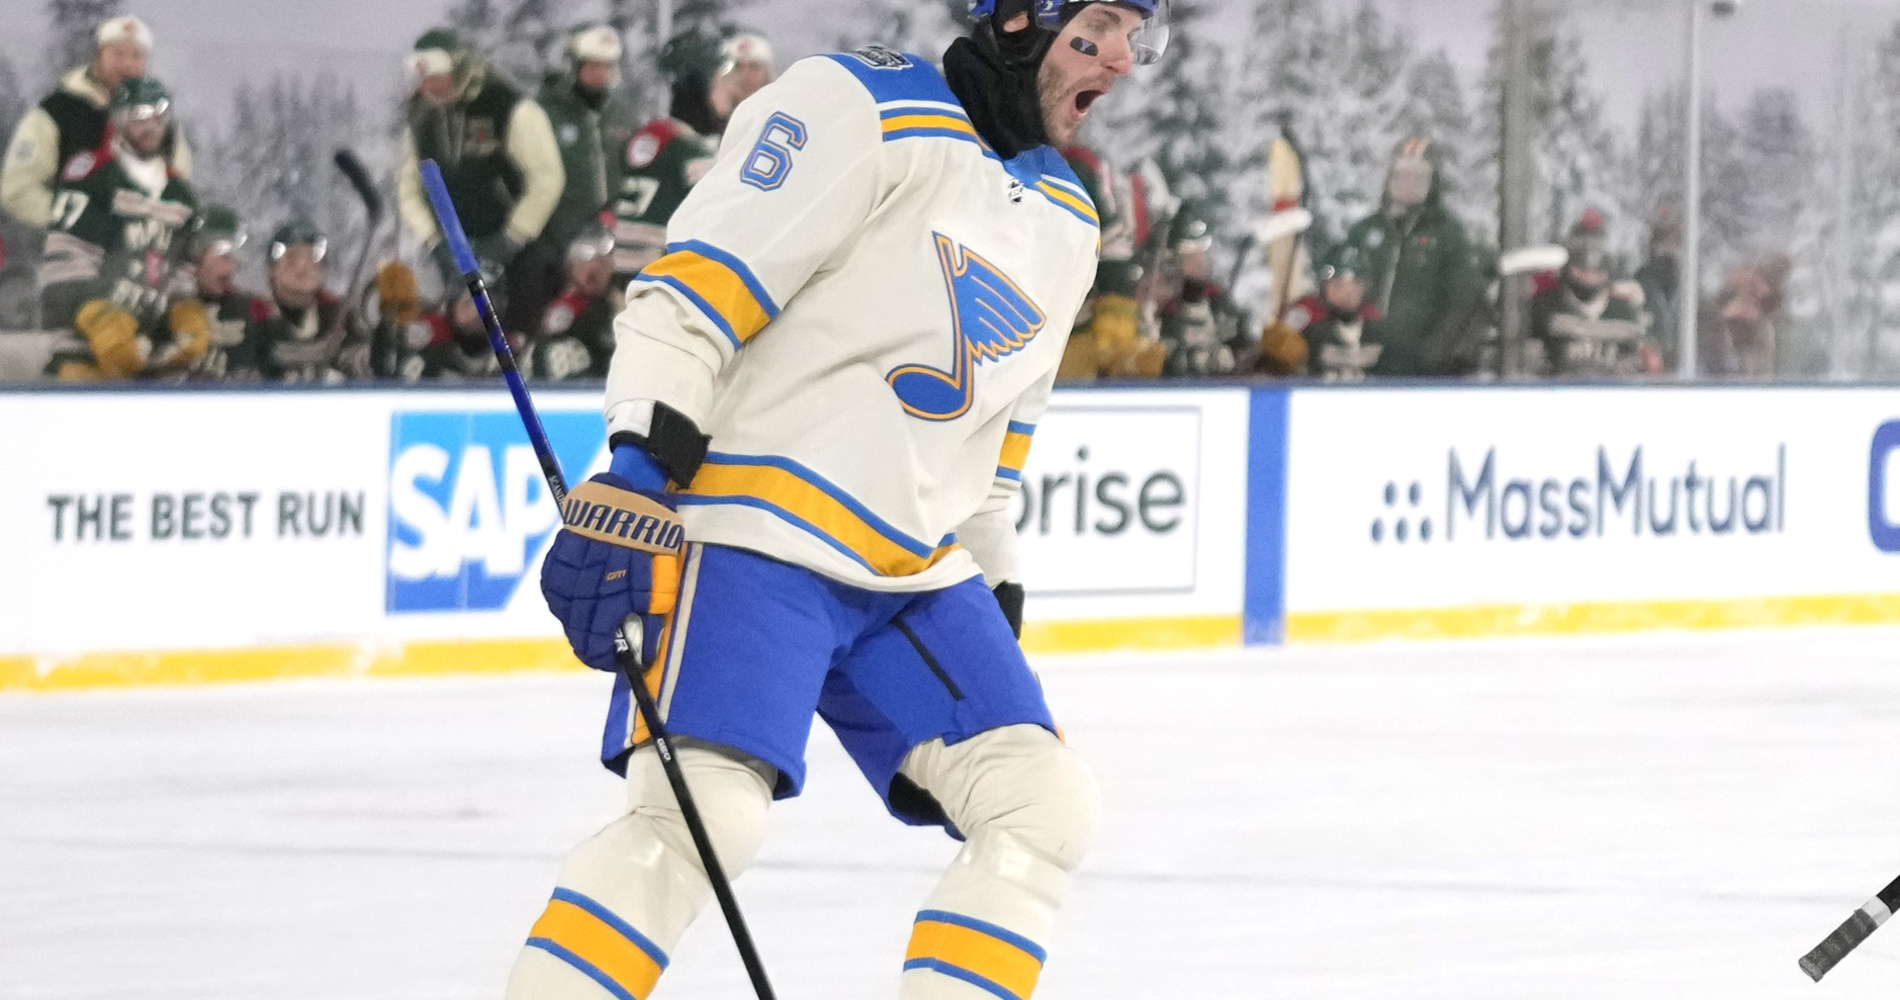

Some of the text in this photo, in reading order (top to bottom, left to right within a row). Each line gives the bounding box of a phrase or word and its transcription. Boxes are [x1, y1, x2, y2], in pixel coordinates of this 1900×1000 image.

[740, 111, 809, 191] 6
[48, 490, 366, 543] THE BEST RUN
[389, 442, 560, 582] SAP
[1446, 441, 1788, 542] MassMutual
